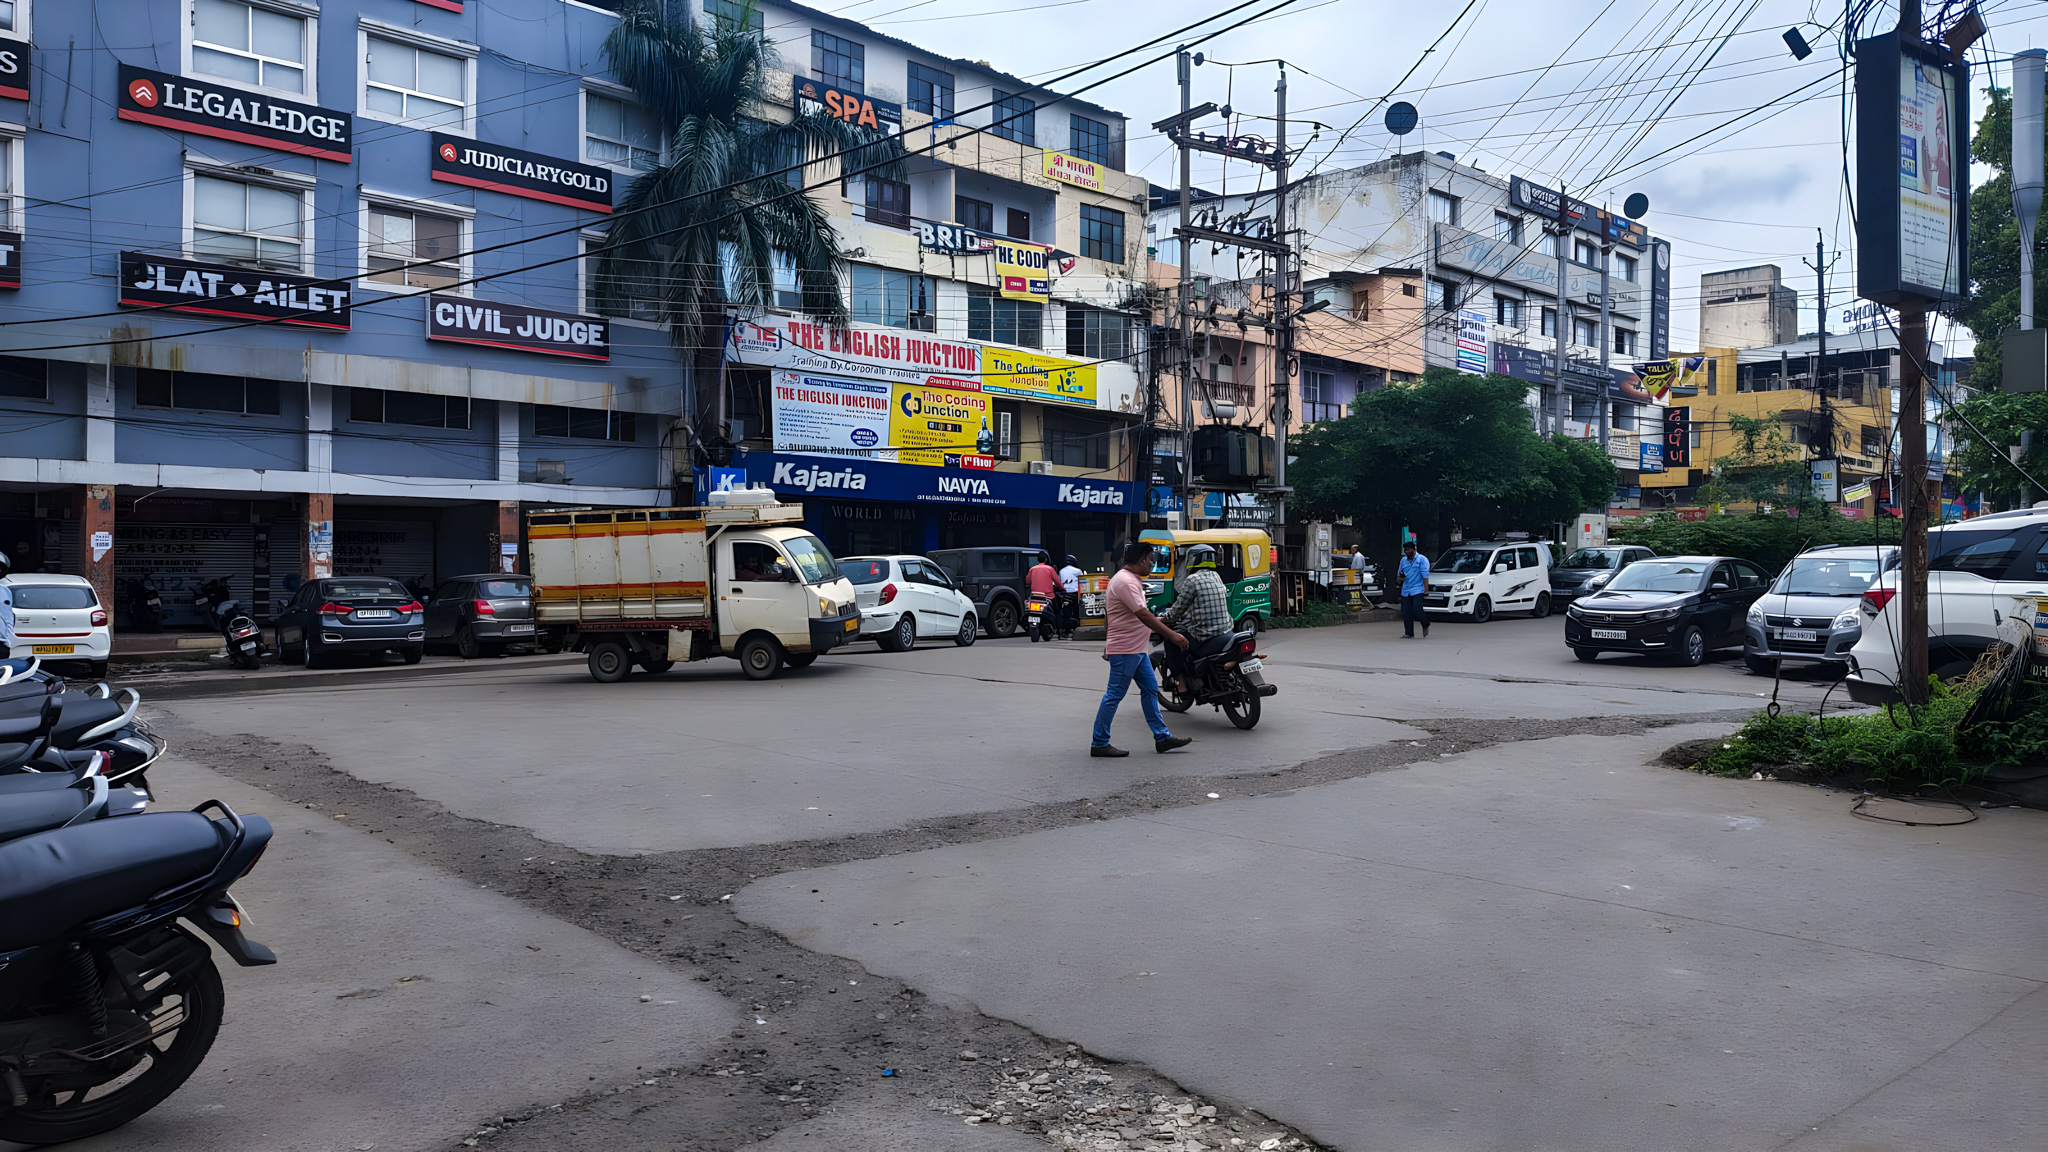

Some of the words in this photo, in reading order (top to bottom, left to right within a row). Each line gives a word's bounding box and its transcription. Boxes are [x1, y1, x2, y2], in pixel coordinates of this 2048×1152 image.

[163, 83, 345, 143] LEGALEDGE
[825, 89, 878, 130] SPA
[460, 149, 608, 193] JUDICIARYGOLD
[253, 280, 347, 314] AILET
[435, 302, 510, 335] CIVIL
[516, 315, 604, 348] JUDGE
[788, 321, 824, 350] THE
[829, 328, 901, 361] ENGLISH
[906, 338, 976, 371] JUNCTION
[792, 354, 828, 369] Training
[993, 359, 1012, 371] The
[1009, 374, 1049, 388] Junction
[775, 386, 795, 401] THE
[797, 389, 839, 405] ENGLISH
[841, 394, 888, 410] JUNCTION
[922, 391, 942, 403] The
[945, 393, 986, 411] Coding
[720, 473, 737, 492] K
[772, 462, 867, 492] Kajaria
[938, 476, 990, 496] NAVYA
[1057, 483, 1124, 508] Kajaria
[831, 505, 883, 520] WORLD
